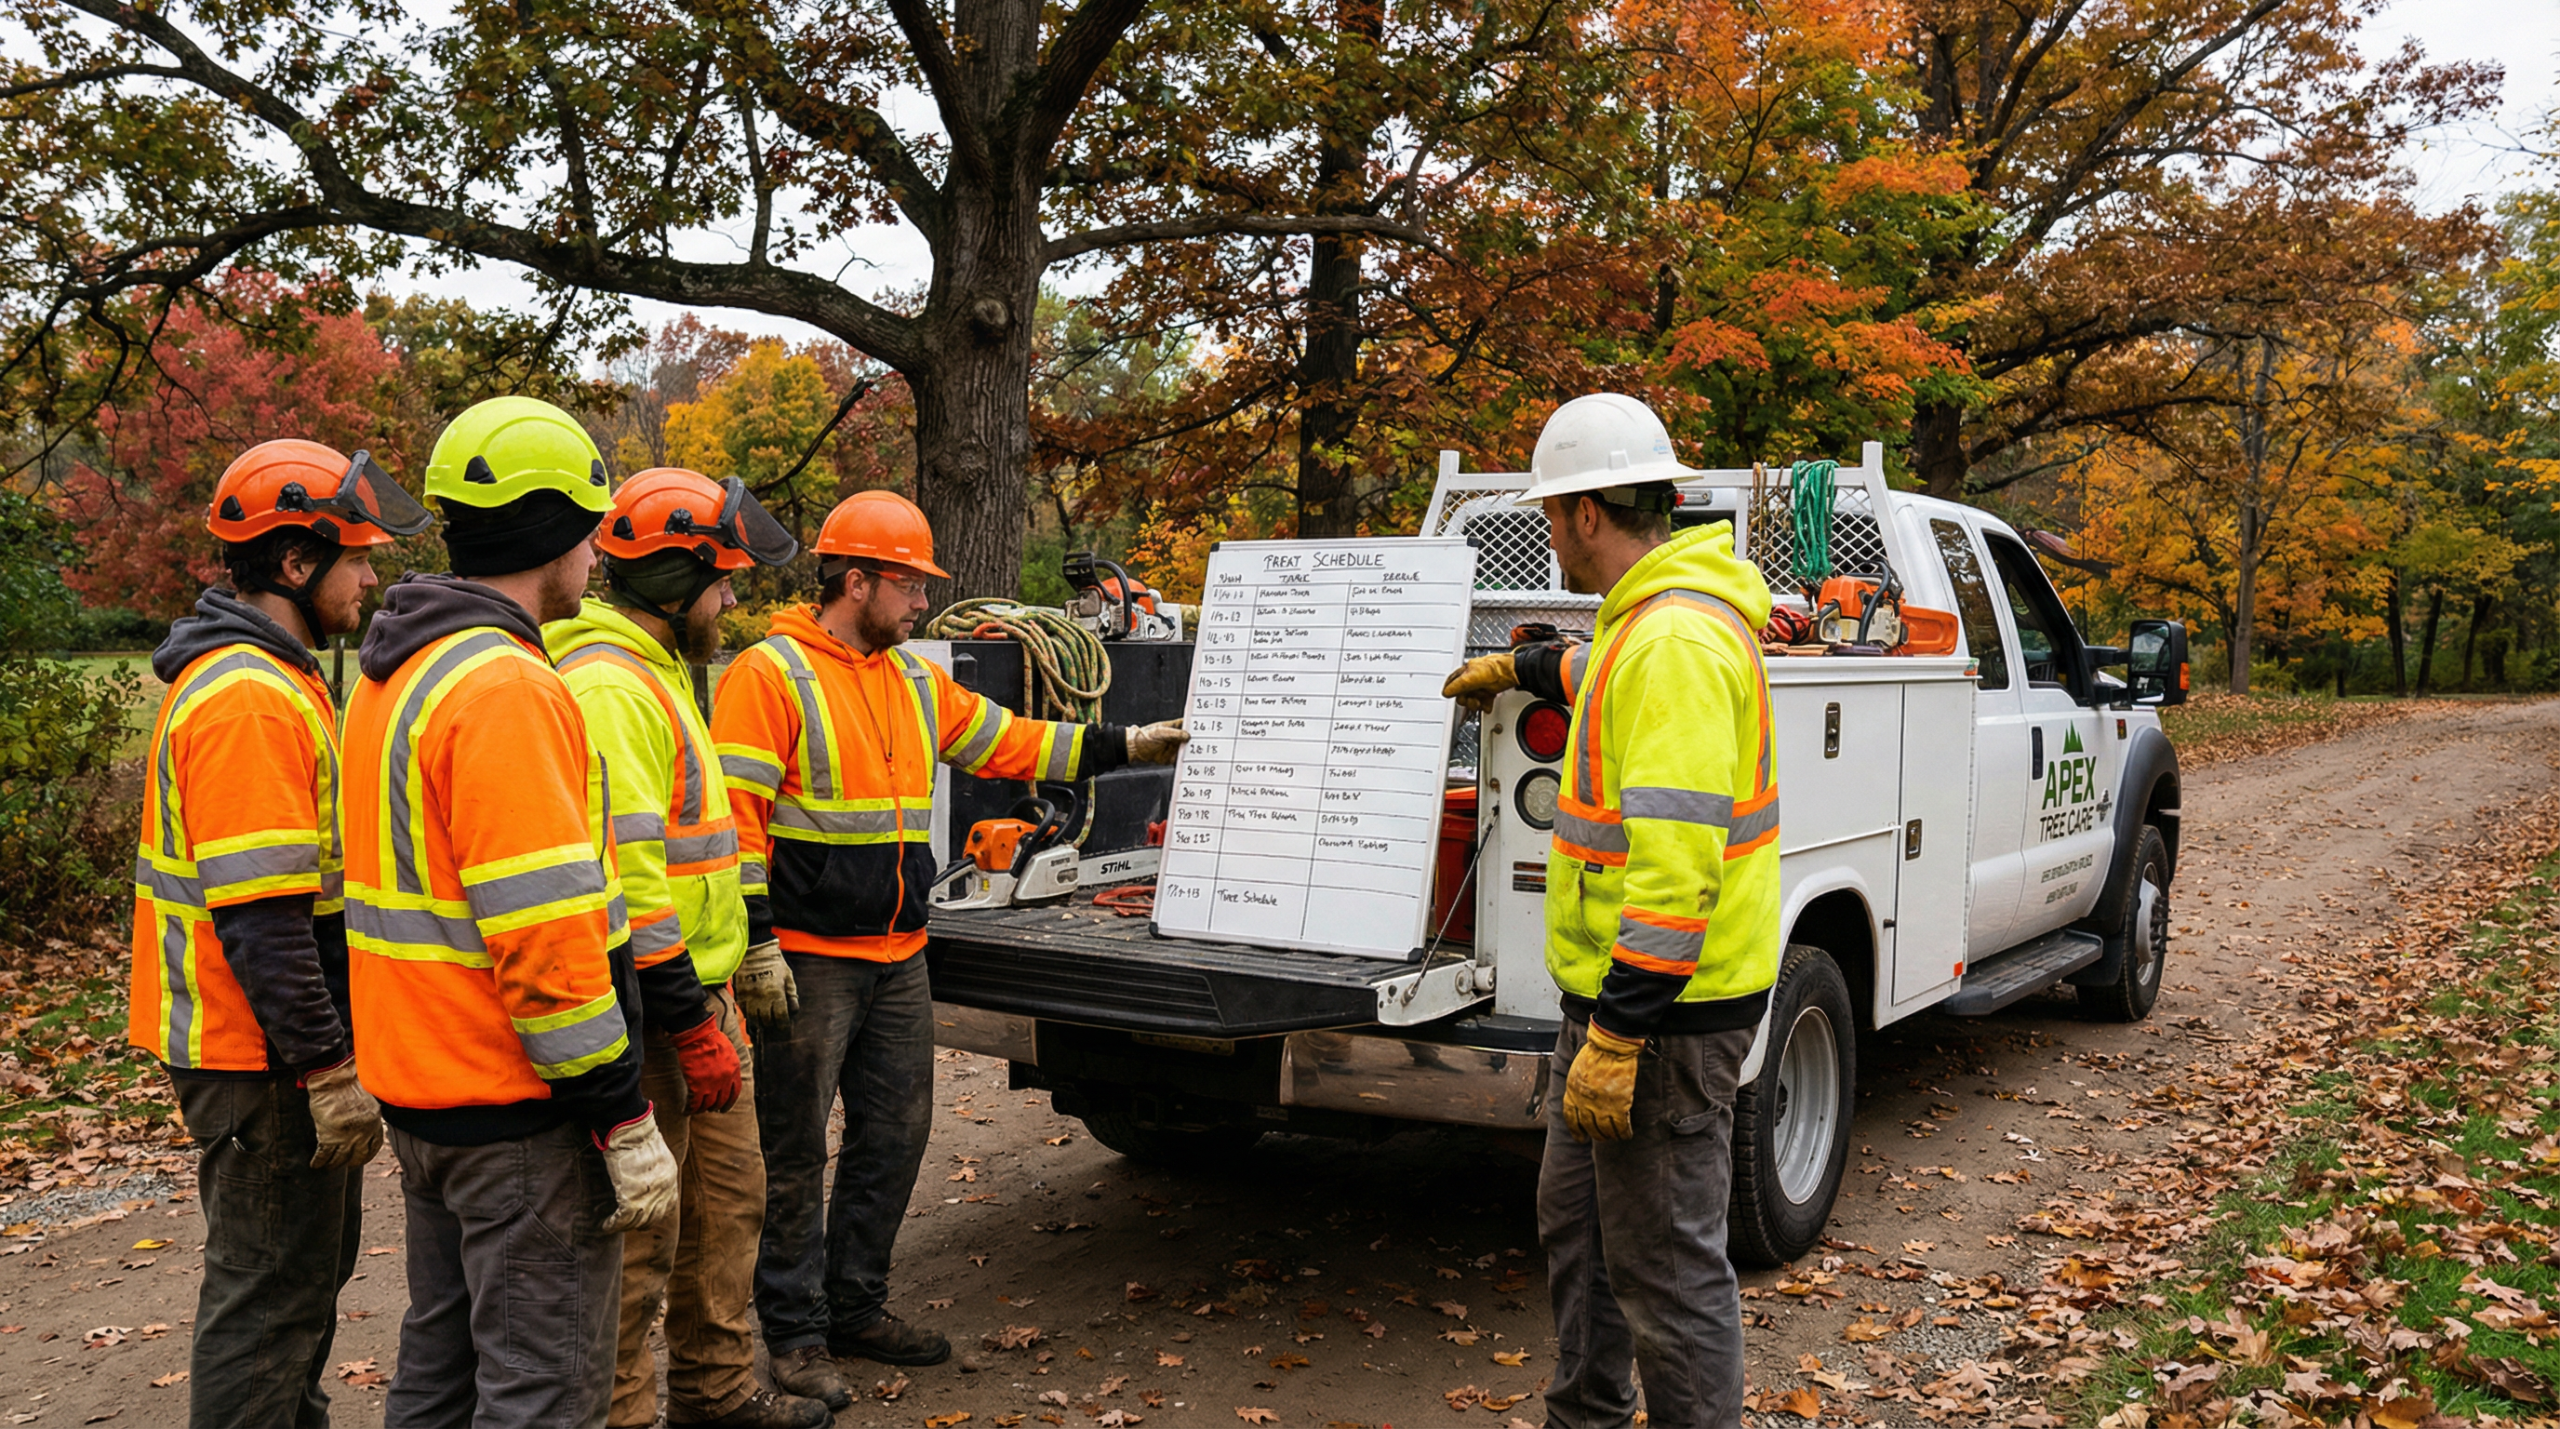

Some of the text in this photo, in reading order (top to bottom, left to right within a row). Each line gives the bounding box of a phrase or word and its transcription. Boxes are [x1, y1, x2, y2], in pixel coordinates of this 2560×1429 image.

[1312, 551, 1386, 568] SCHEDULE
[2041, 756, 2097, 810] APEX
[2040, 806, 2094, 842] TREE CARE
